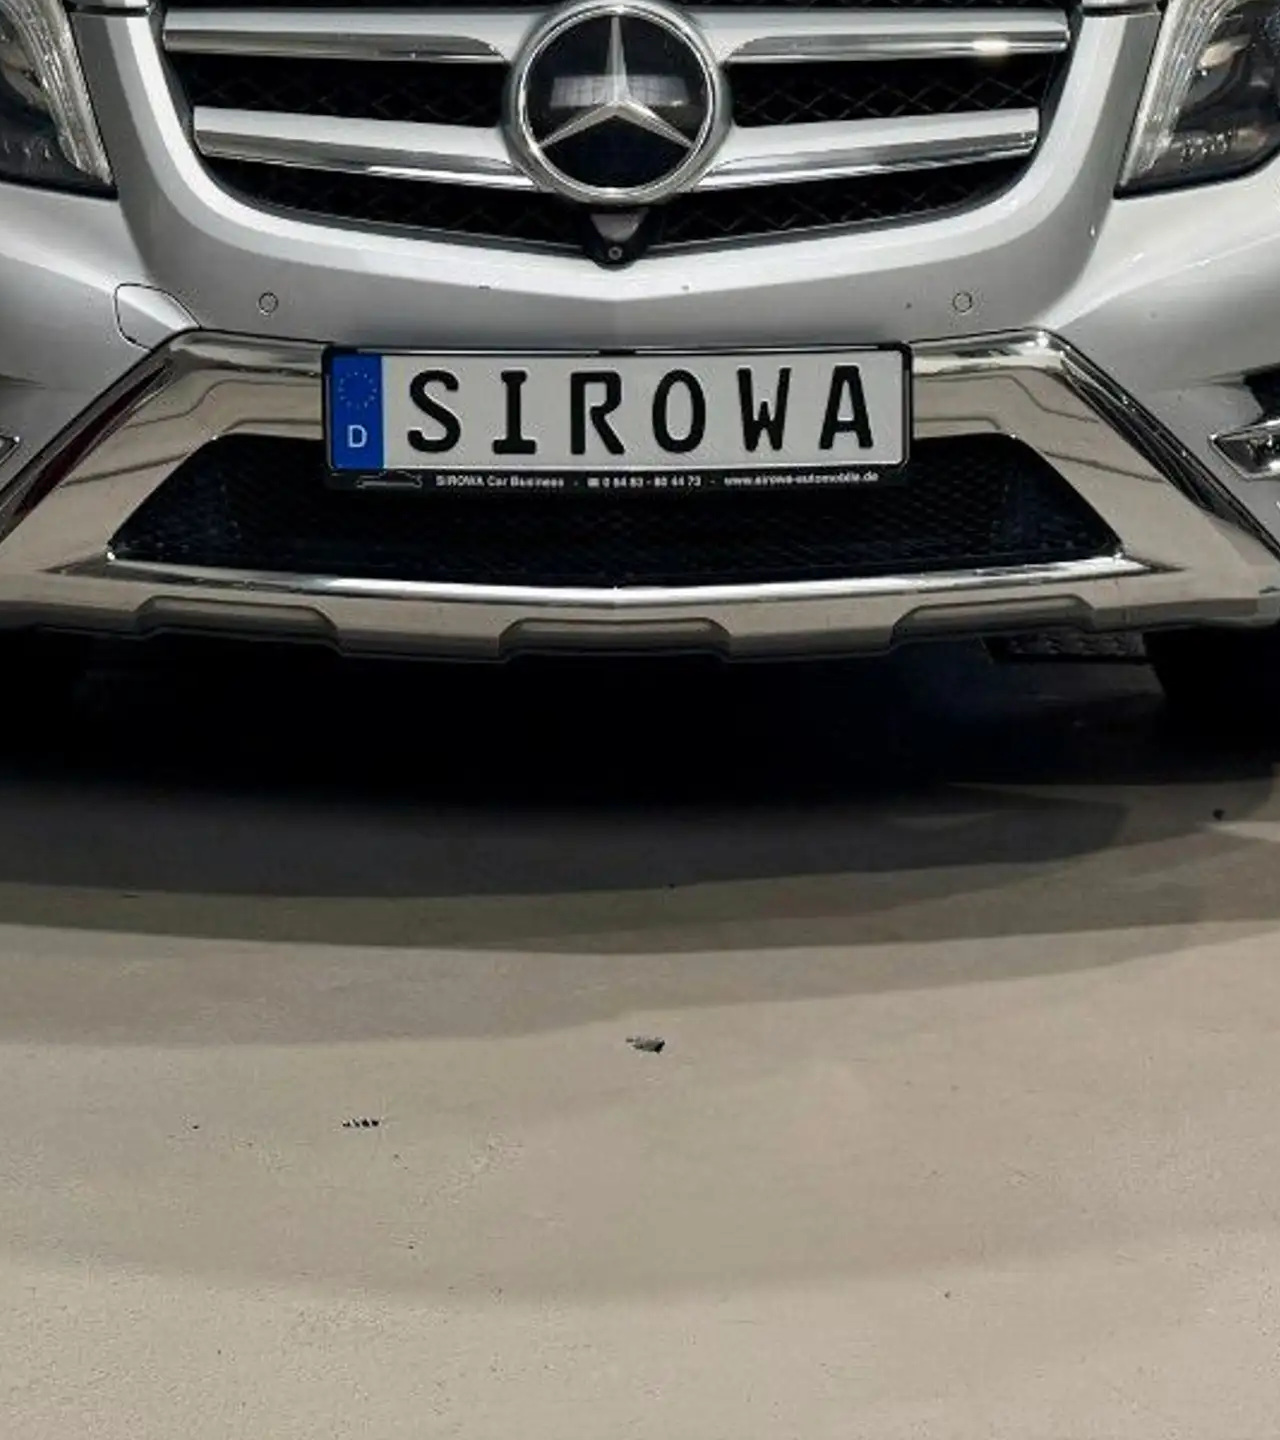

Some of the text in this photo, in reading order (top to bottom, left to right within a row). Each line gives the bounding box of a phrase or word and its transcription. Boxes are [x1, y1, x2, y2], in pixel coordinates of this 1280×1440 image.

[407, 365, 875, 456] SIROWA
[348, 425, 368, 449] D
[486, 474, 508, 487] Car
